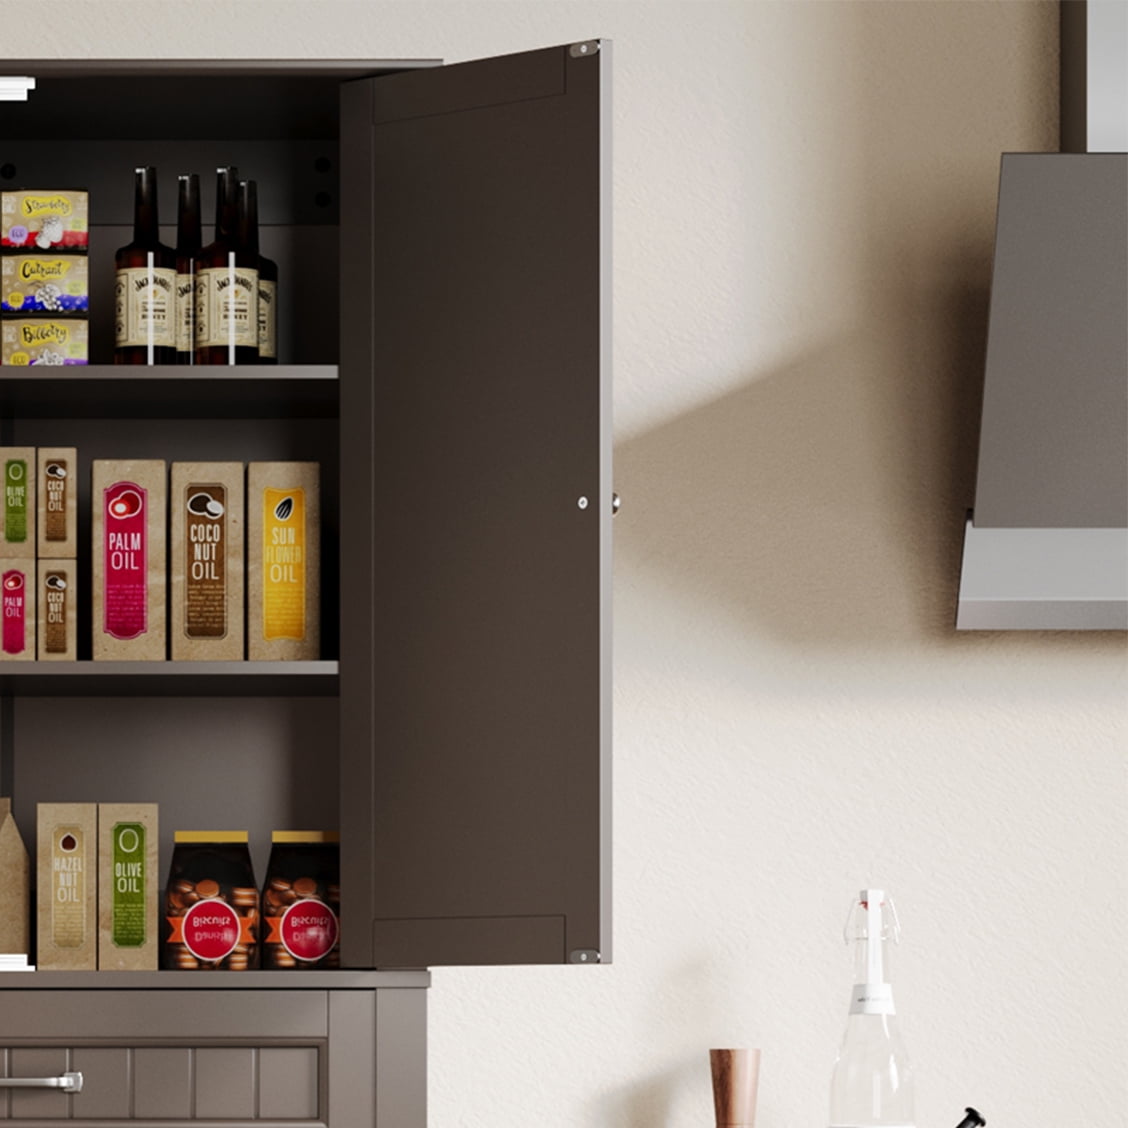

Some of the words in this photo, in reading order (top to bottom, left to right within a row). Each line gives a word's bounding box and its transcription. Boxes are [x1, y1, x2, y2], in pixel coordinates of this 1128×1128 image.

[6, 486, 25, 496] OLIVE
[47, 480, 64, 491] COCO
[8, 496, 24, 507] OIL
[48, 501, 63, 511] OIL
[190, 524, 221, 542] COCO
[271, 527, 296, 545] SUN
[109, 532, 141, 550] PALM
[194, 543, 216, 561] NUT
[265, 546, 301, 564] FLOWER
[111, 552, 139, 570] OIL
[191, 562, 219, 580] OIL
[269, 564, 297, 583] OIL
[4, 597, 22, 607] PALM
[47, 592, 64, 603] COCO
[5, 607, 21, 617] OIL
[48, 613, 63, 623] OIL
[53, 857, 82, 872] HAZEL
[115, 862, 142, 877] OLIVE
[59, 872, 78, 886] NUT
[117, 878, 140, 893] OIL
[57, 887, 80, 902] OIL
